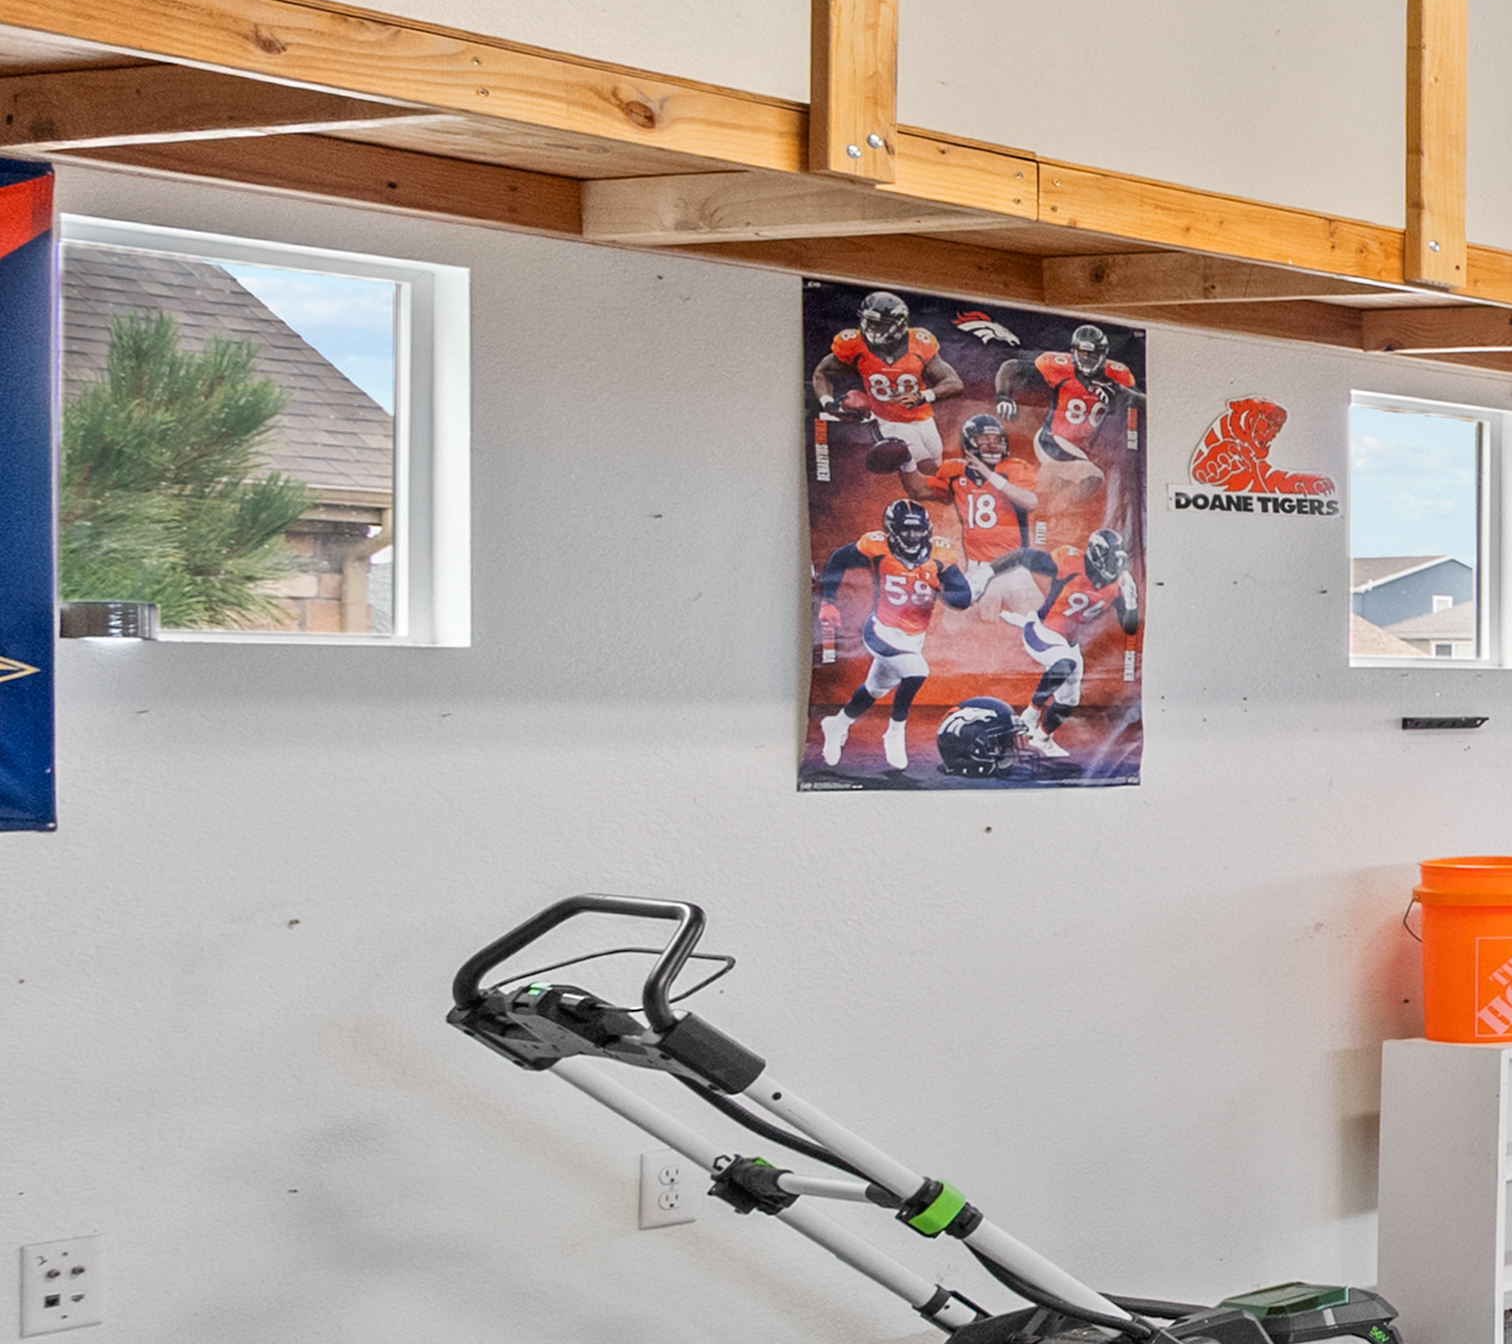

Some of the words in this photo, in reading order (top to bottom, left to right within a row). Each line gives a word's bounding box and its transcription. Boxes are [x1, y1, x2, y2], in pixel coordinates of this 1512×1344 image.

[869, 374, 919, 402] 88
[1064, 398, 1107, 428] 80
[966, 493, 997, 529] 18
[1175, 492, 1254, 512] DOANE
[1257, 497, 1339, 515] TIGERS
